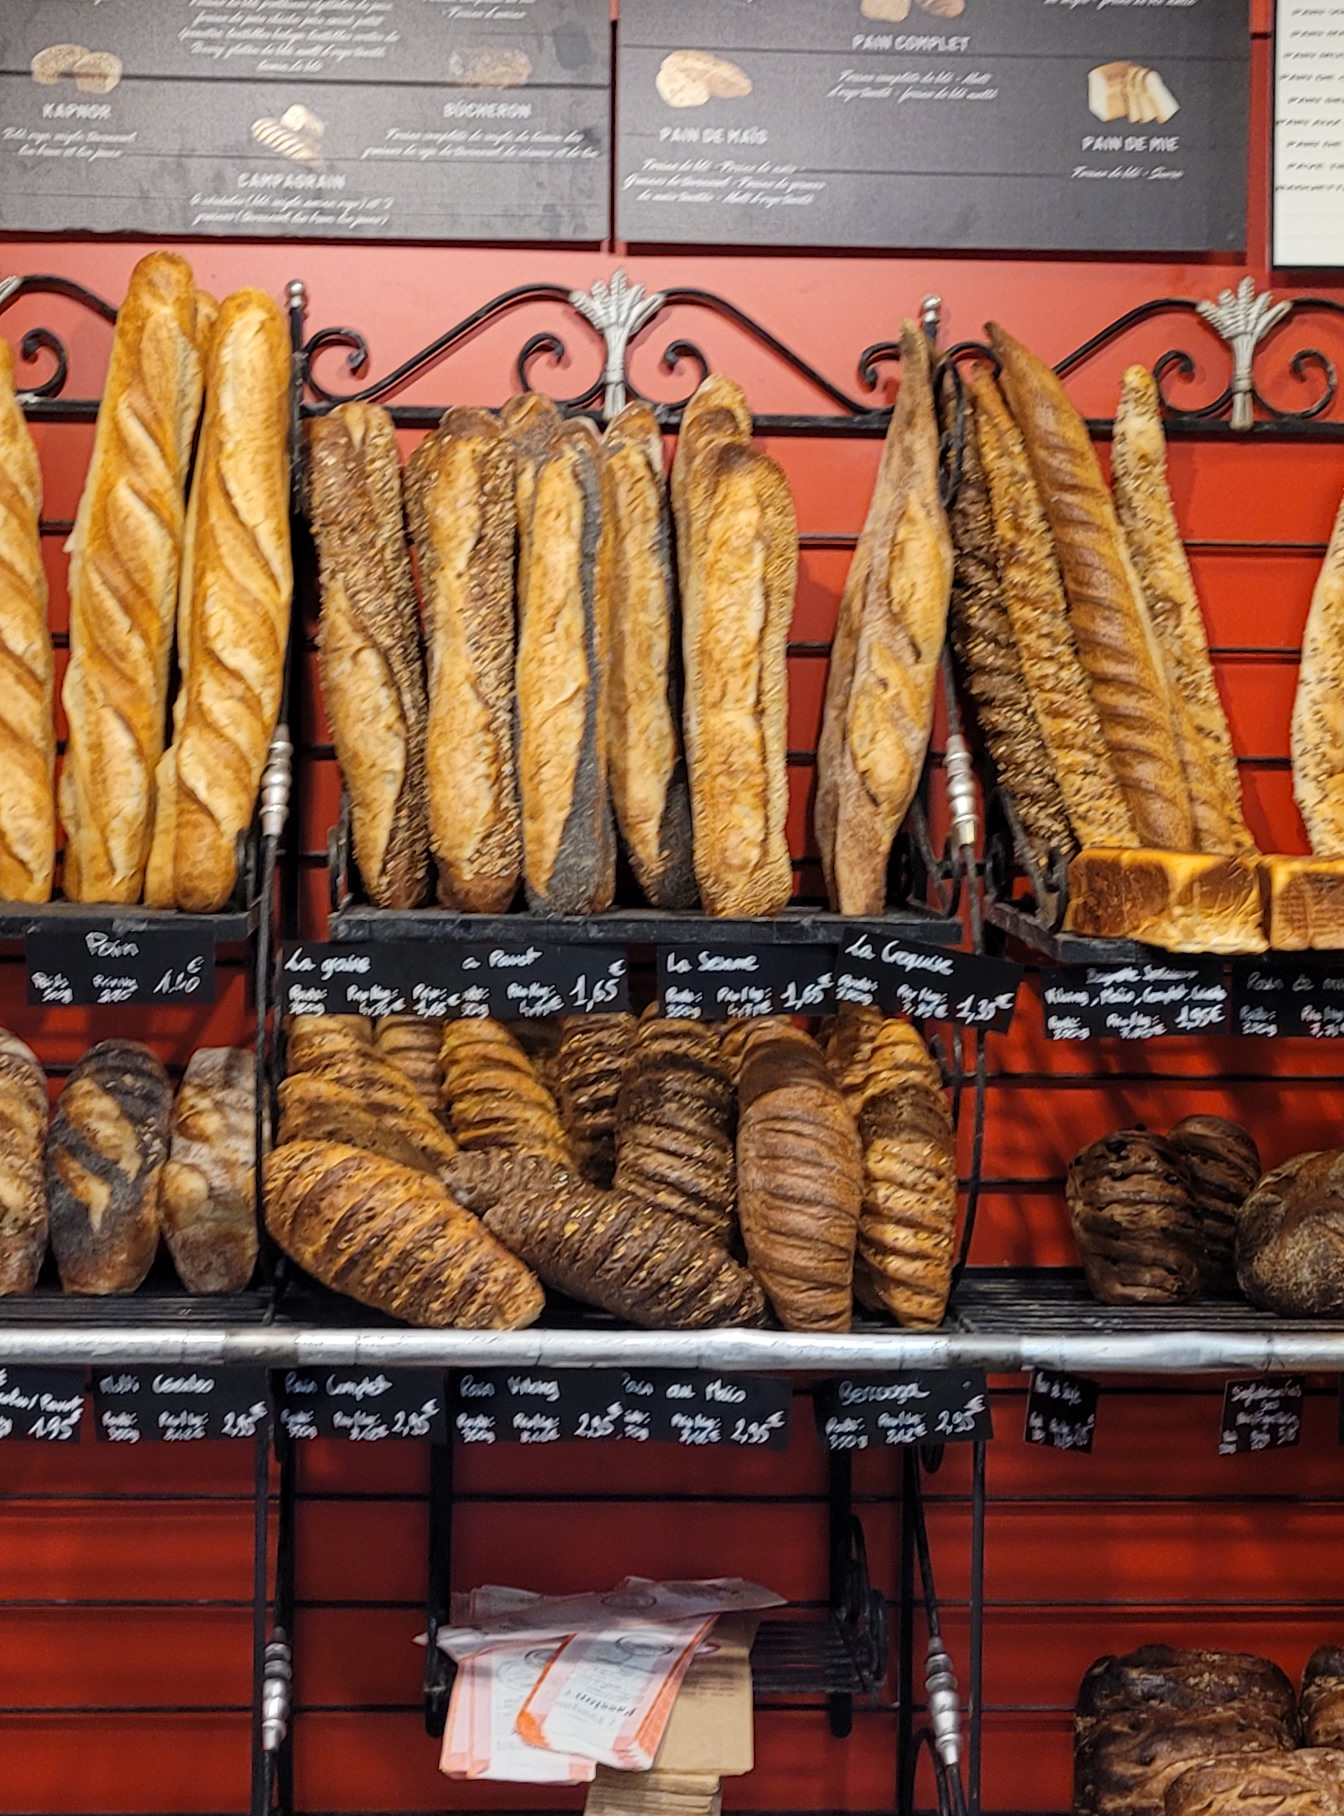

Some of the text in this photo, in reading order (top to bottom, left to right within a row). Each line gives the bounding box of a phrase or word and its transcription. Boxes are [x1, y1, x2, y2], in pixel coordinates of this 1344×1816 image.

[852, 34, 970, 51] PAIN COMPLET
[659, 127, 700, 143] PAIN
[702, 128, 725, 144] DE
[1081, 136, 1180, 152] PAIN DE MIE
[845, 934, 876, 960] La
[667, 952, 693, 973] La
